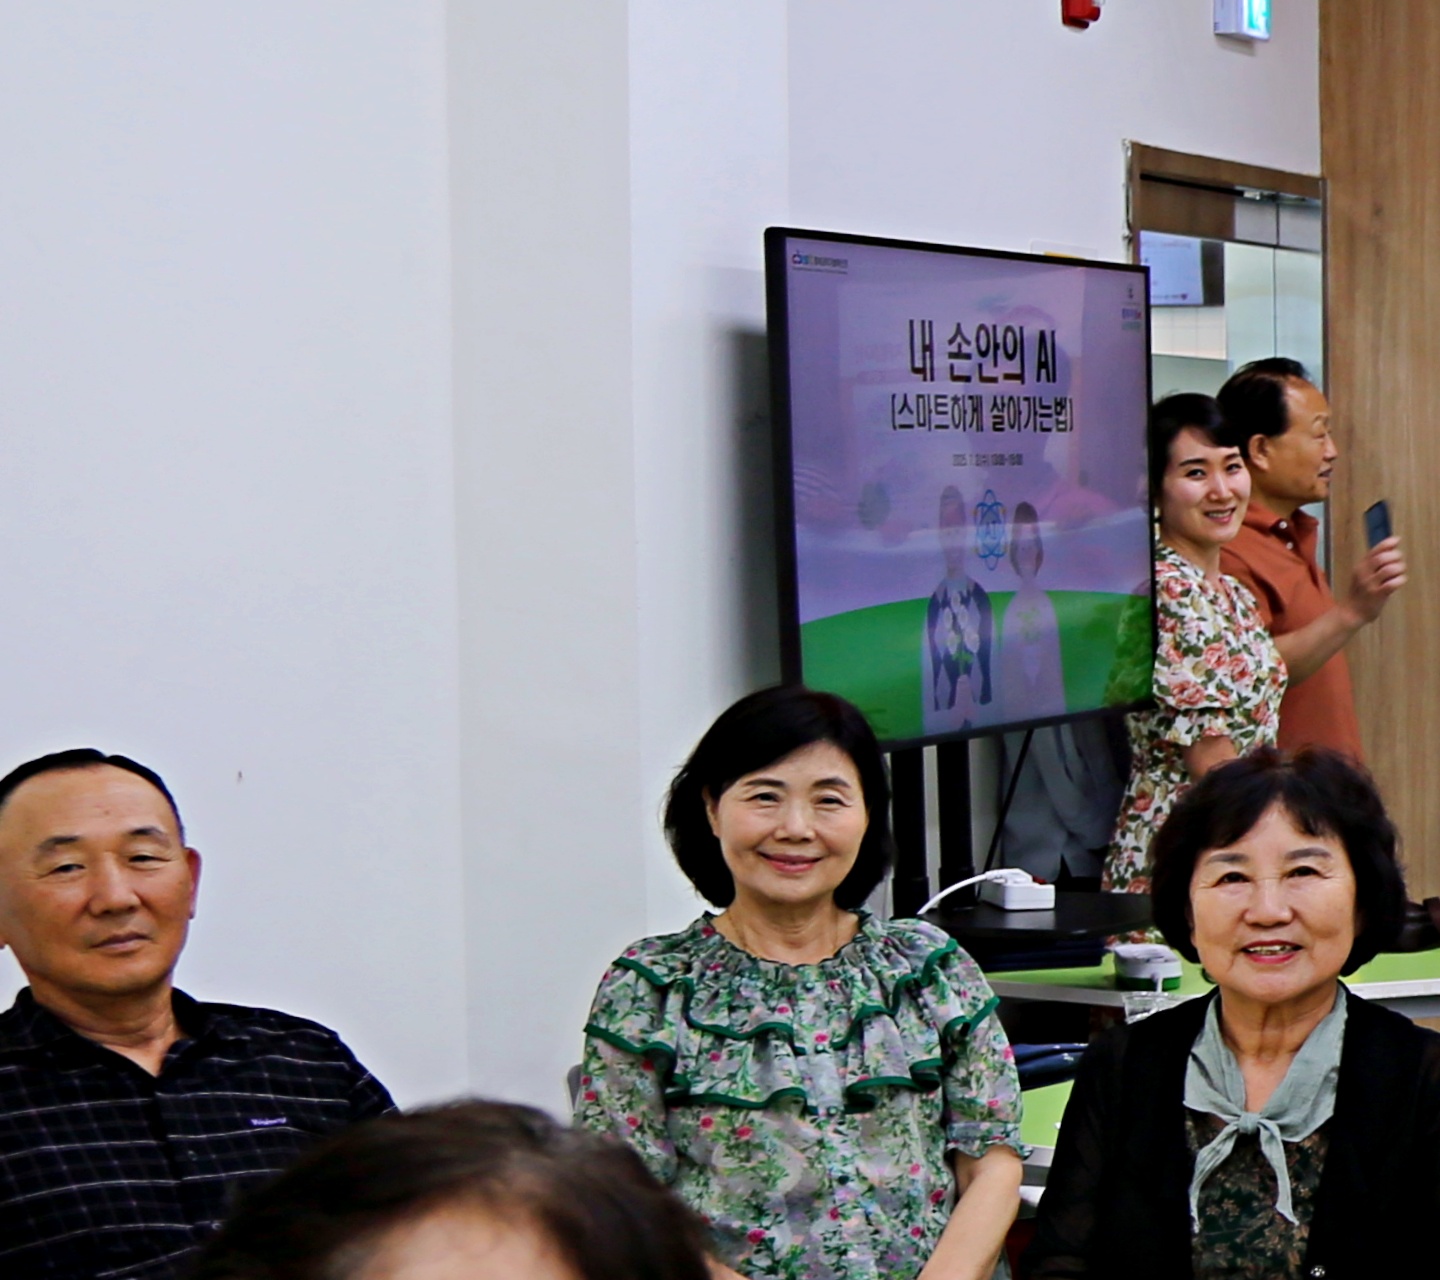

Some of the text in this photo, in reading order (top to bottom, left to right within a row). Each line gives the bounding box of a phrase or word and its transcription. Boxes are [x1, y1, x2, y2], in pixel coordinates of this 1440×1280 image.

[909, 319, 1057, 385] 내 손안의 AI
